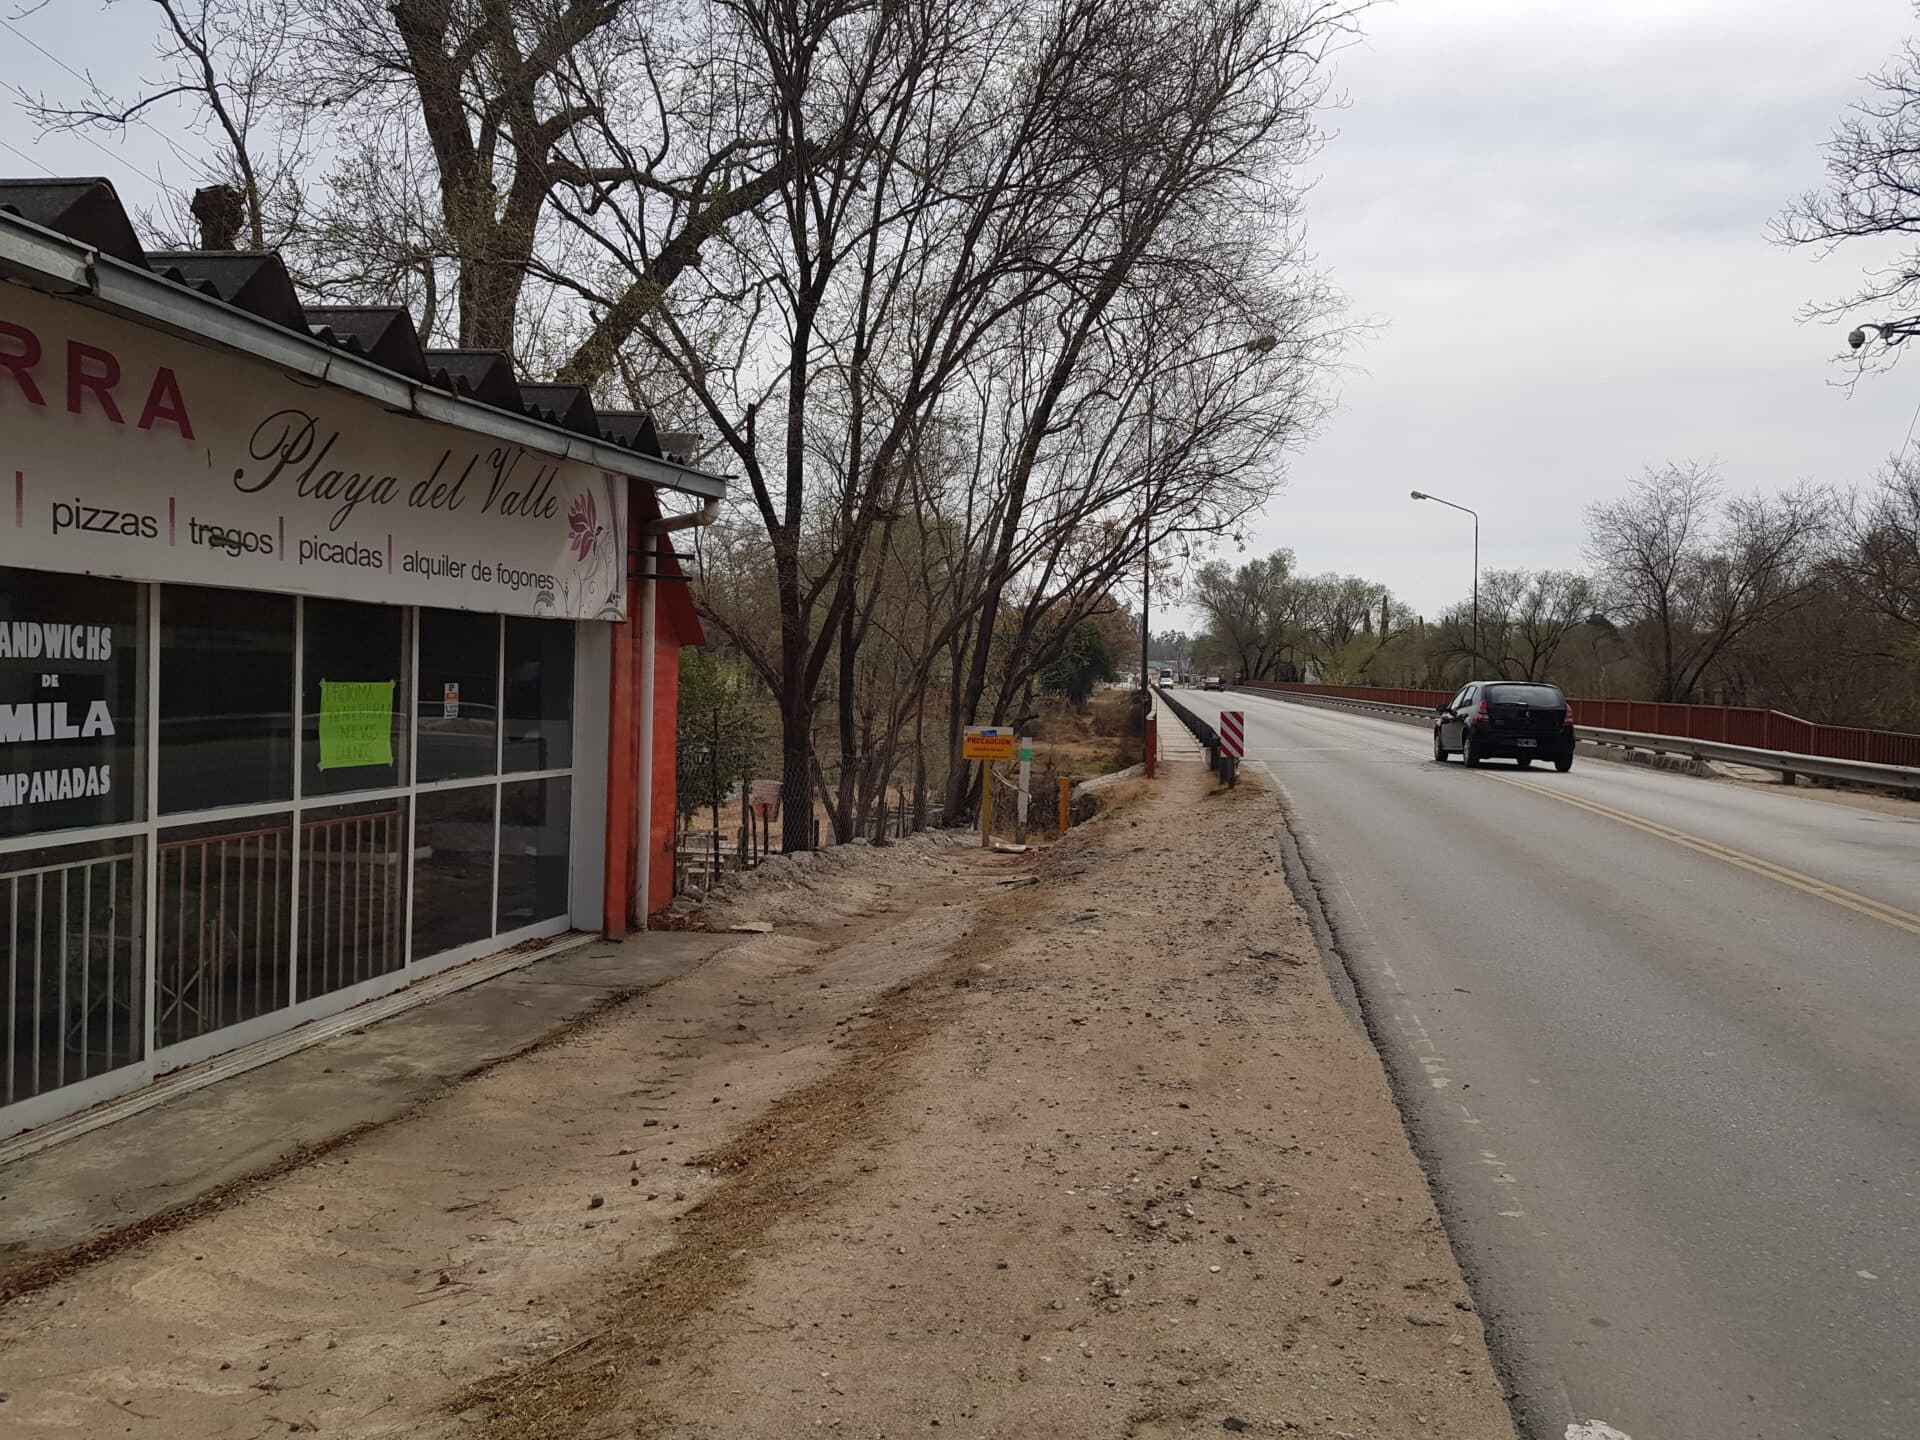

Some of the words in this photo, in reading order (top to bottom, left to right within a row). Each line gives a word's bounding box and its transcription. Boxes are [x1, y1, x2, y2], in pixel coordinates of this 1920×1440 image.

[234, 410, 399, 532] Playa
[408, 450, 466, 511] del
[471, 446, 560, 519] Valle
[52, 498, 158, 539] pizzas
[189, 517, 274, 558] tragos
[299, 536, 384, 569] picadas
[402, 550, 467, 580] alquiler
[471, 560, 493, 583] de
[497, 563, 555, 591] fogones
[41, 674, 59, 687] DE
[0, 700, 116, 742] MILA
